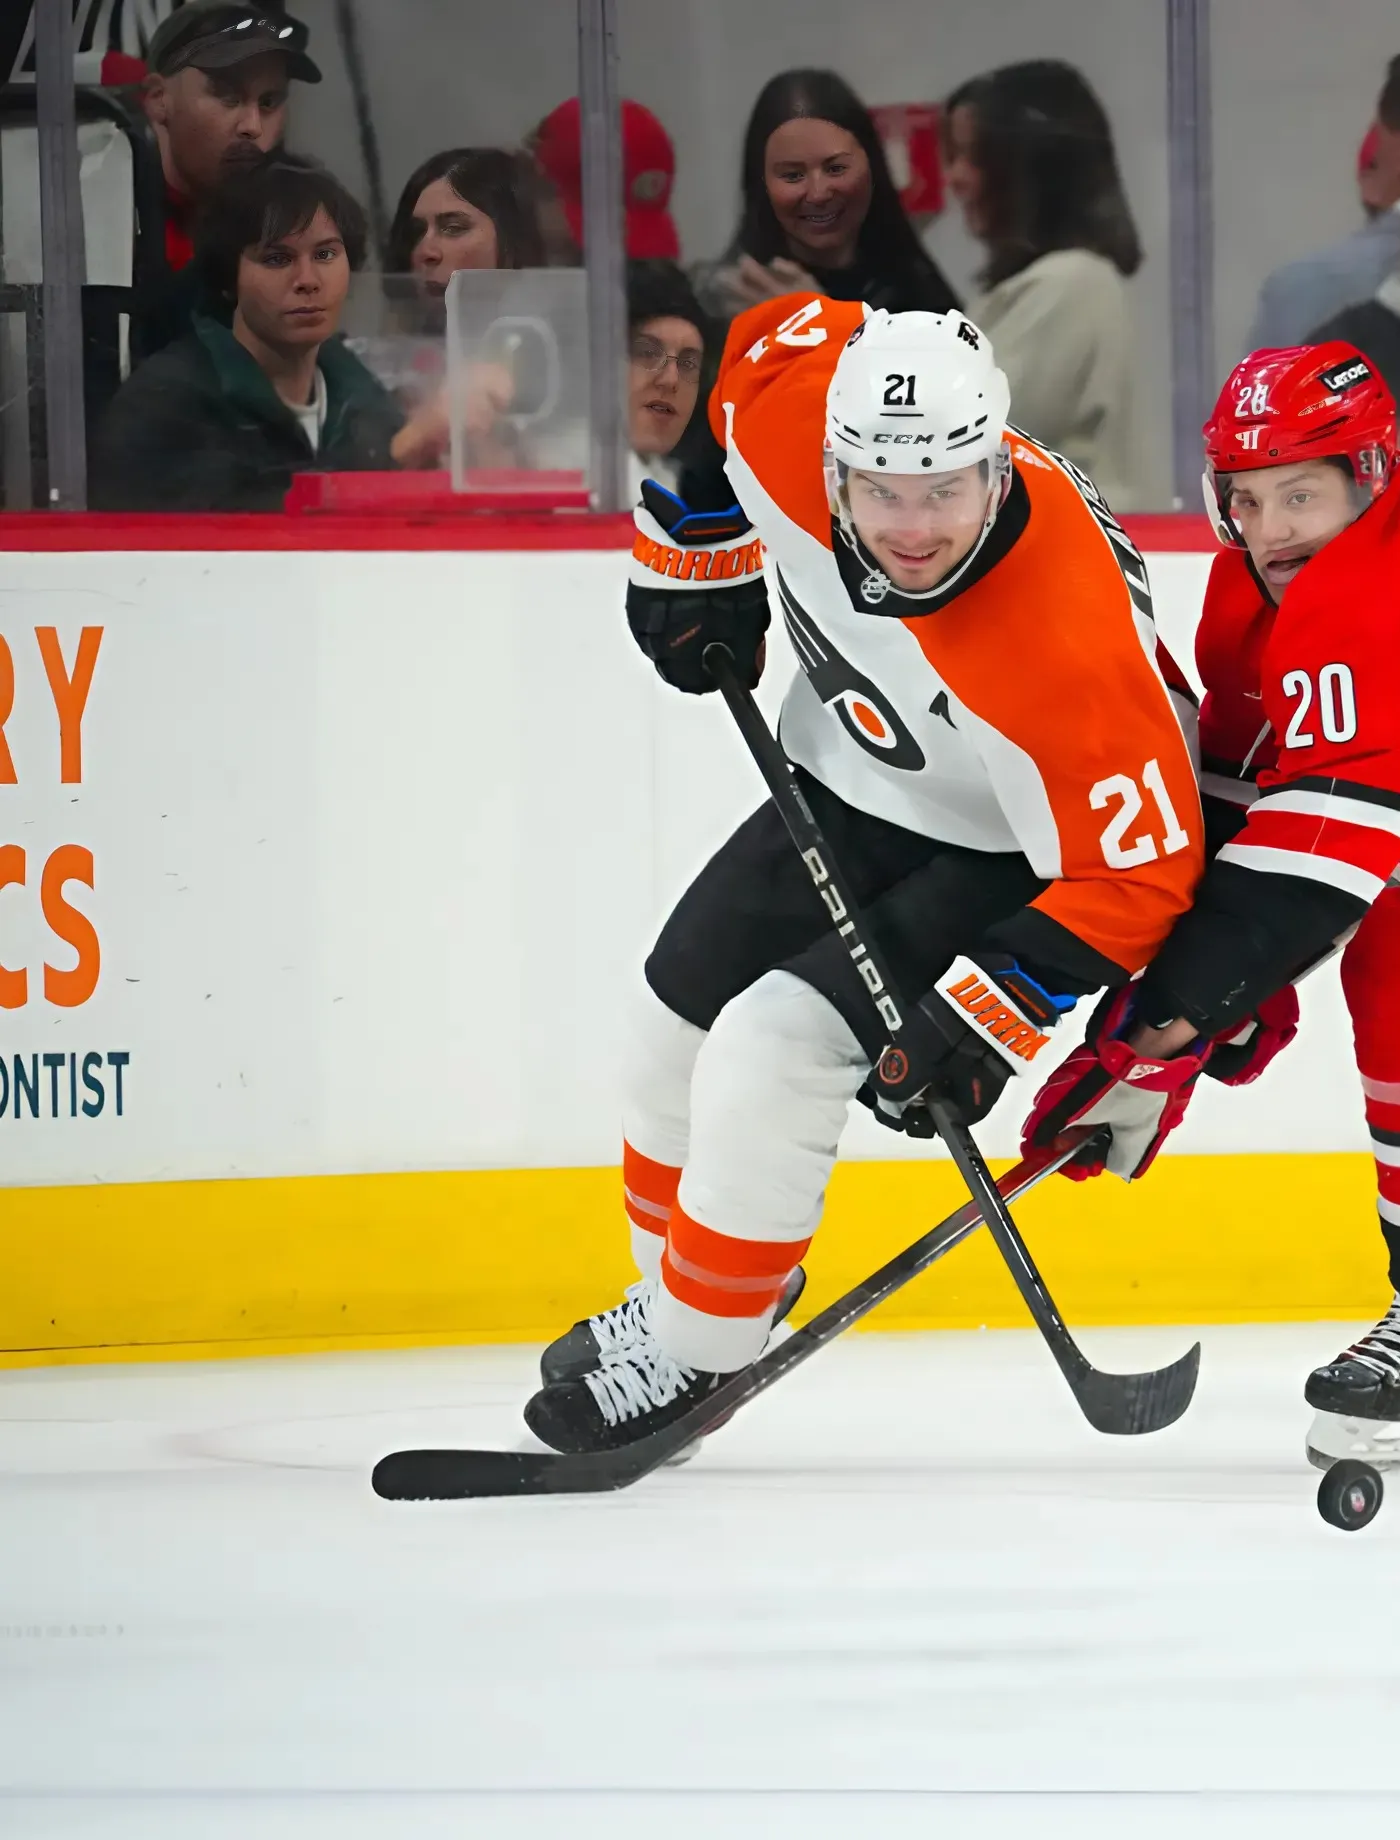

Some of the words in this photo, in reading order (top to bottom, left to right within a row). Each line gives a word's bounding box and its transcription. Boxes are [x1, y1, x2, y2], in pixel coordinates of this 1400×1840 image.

[883, 373, 916, 406] 21
[873, 433, 935, 445] CCM
[632, 535, 764, 582] WARRIOR
[1281, 662, 1358, 750] 20
[1088, 758, 1190, 869] 21
